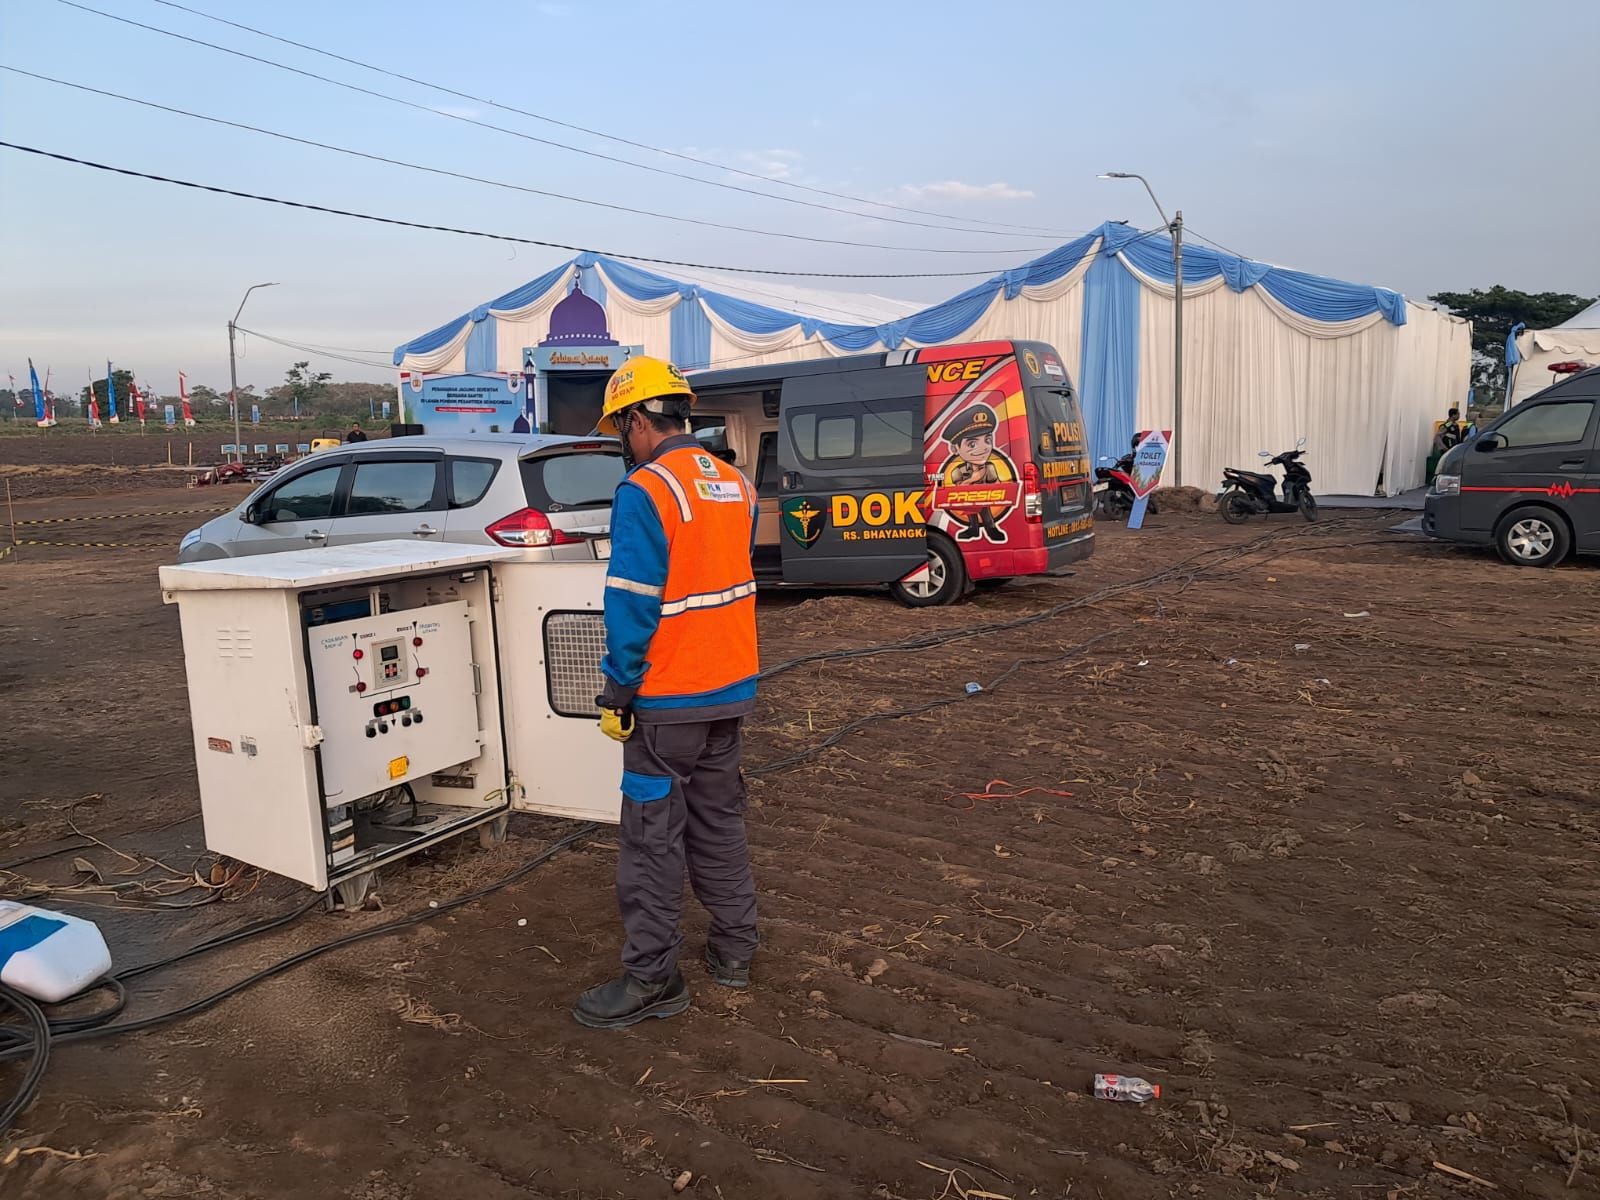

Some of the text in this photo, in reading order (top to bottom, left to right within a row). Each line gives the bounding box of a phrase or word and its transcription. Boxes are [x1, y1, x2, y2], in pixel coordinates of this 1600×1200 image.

[1140, 452, 1162, 460] TOILET
[928, 472, 945, 482] YANG
[947, 488, 1006, 502] PRESISI
[831, 491, 926, 528] DOK
[843, 532, 860, 540] RS.
